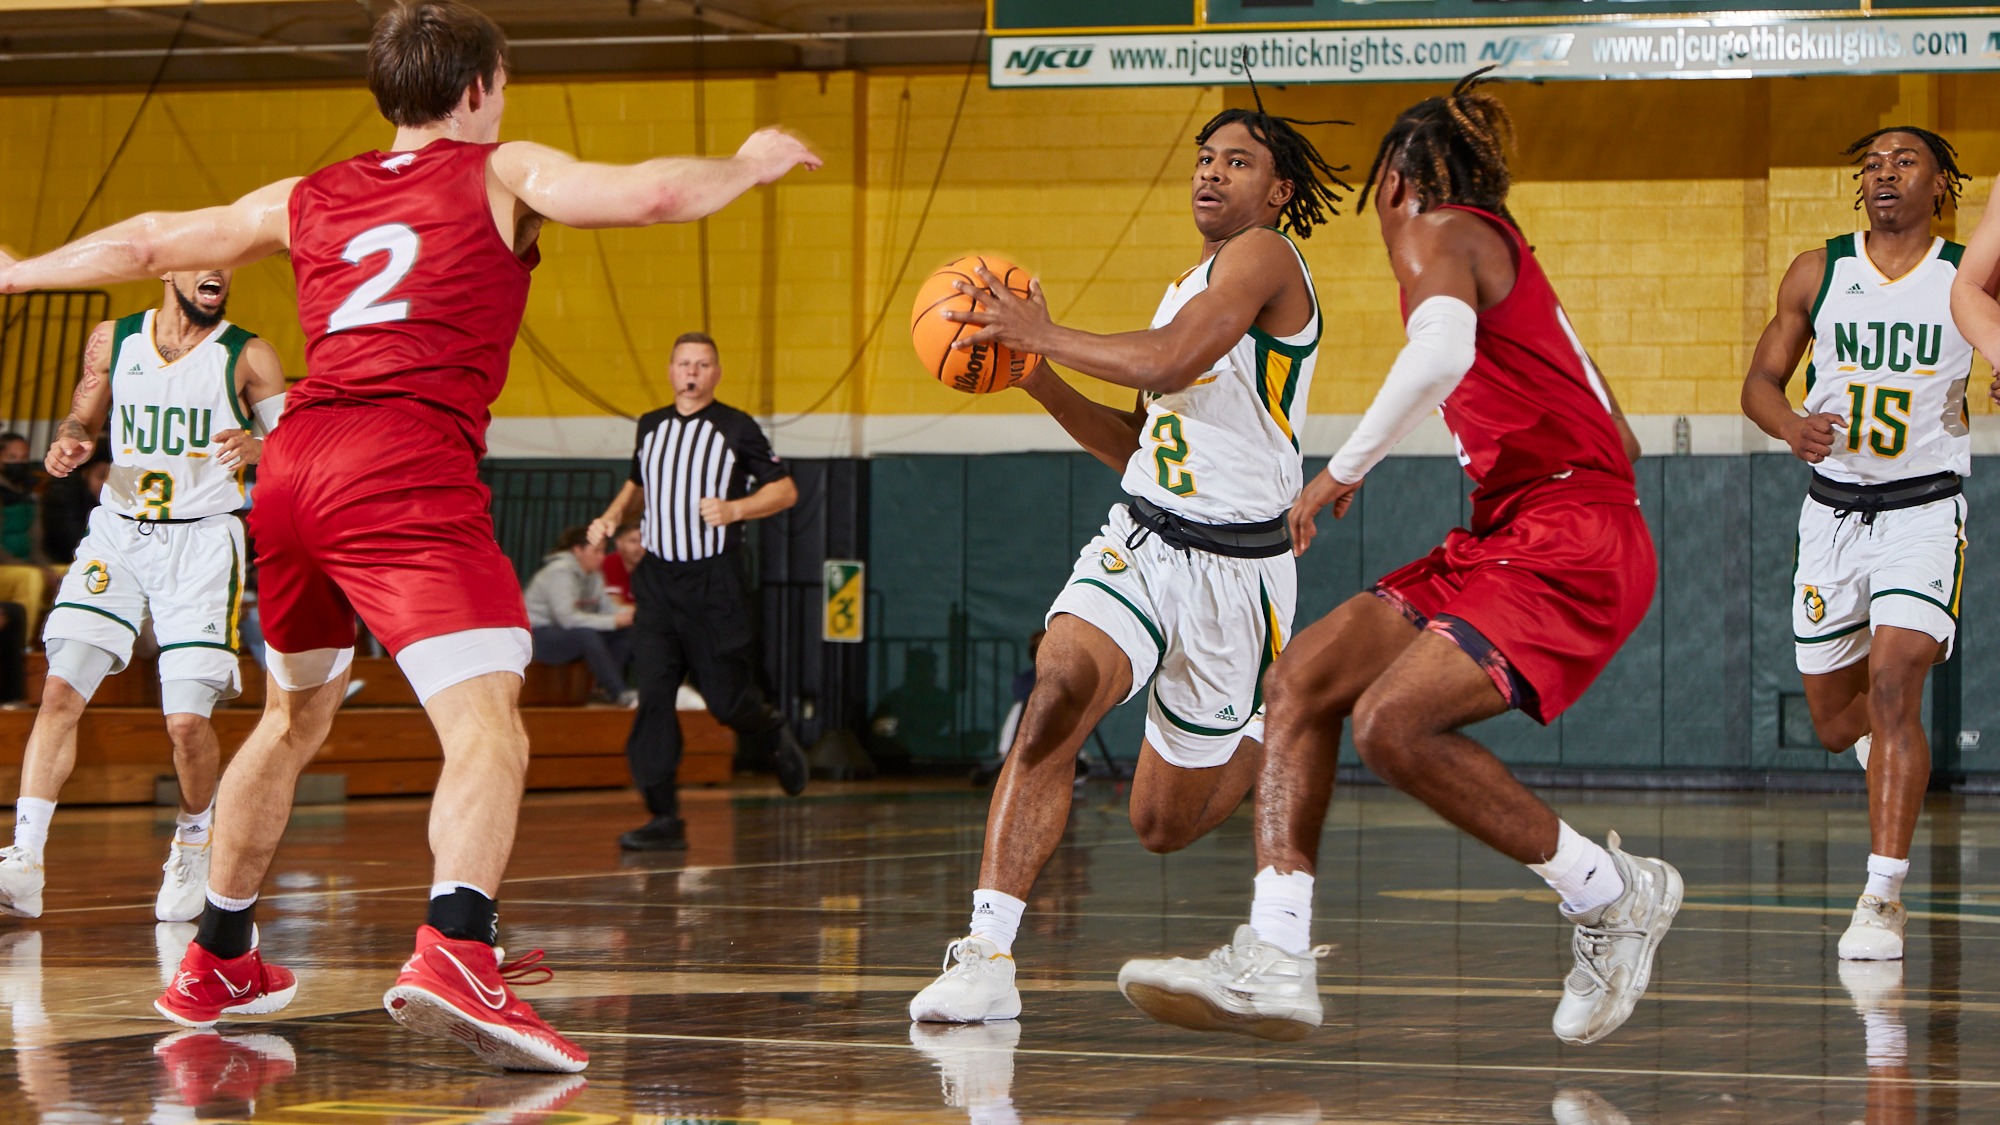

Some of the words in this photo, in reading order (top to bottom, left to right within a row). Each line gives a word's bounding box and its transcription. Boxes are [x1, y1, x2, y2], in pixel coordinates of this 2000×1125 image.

[1005, 44, 1096, 76] NJCU
[1109, 36, 1467, 76] www.njcugothicknights.com
[326, 221, 421, 334] 2
[1834, 321, 1942, 373] NJCU
[121, 405, 211, 456] NJCU
[1846, 381, 1913, 459] 15
[1150, 411, 1198, 497] 2
[136, 470, 175, 519] 3
[1215, 713, 1238, 722] adidas
